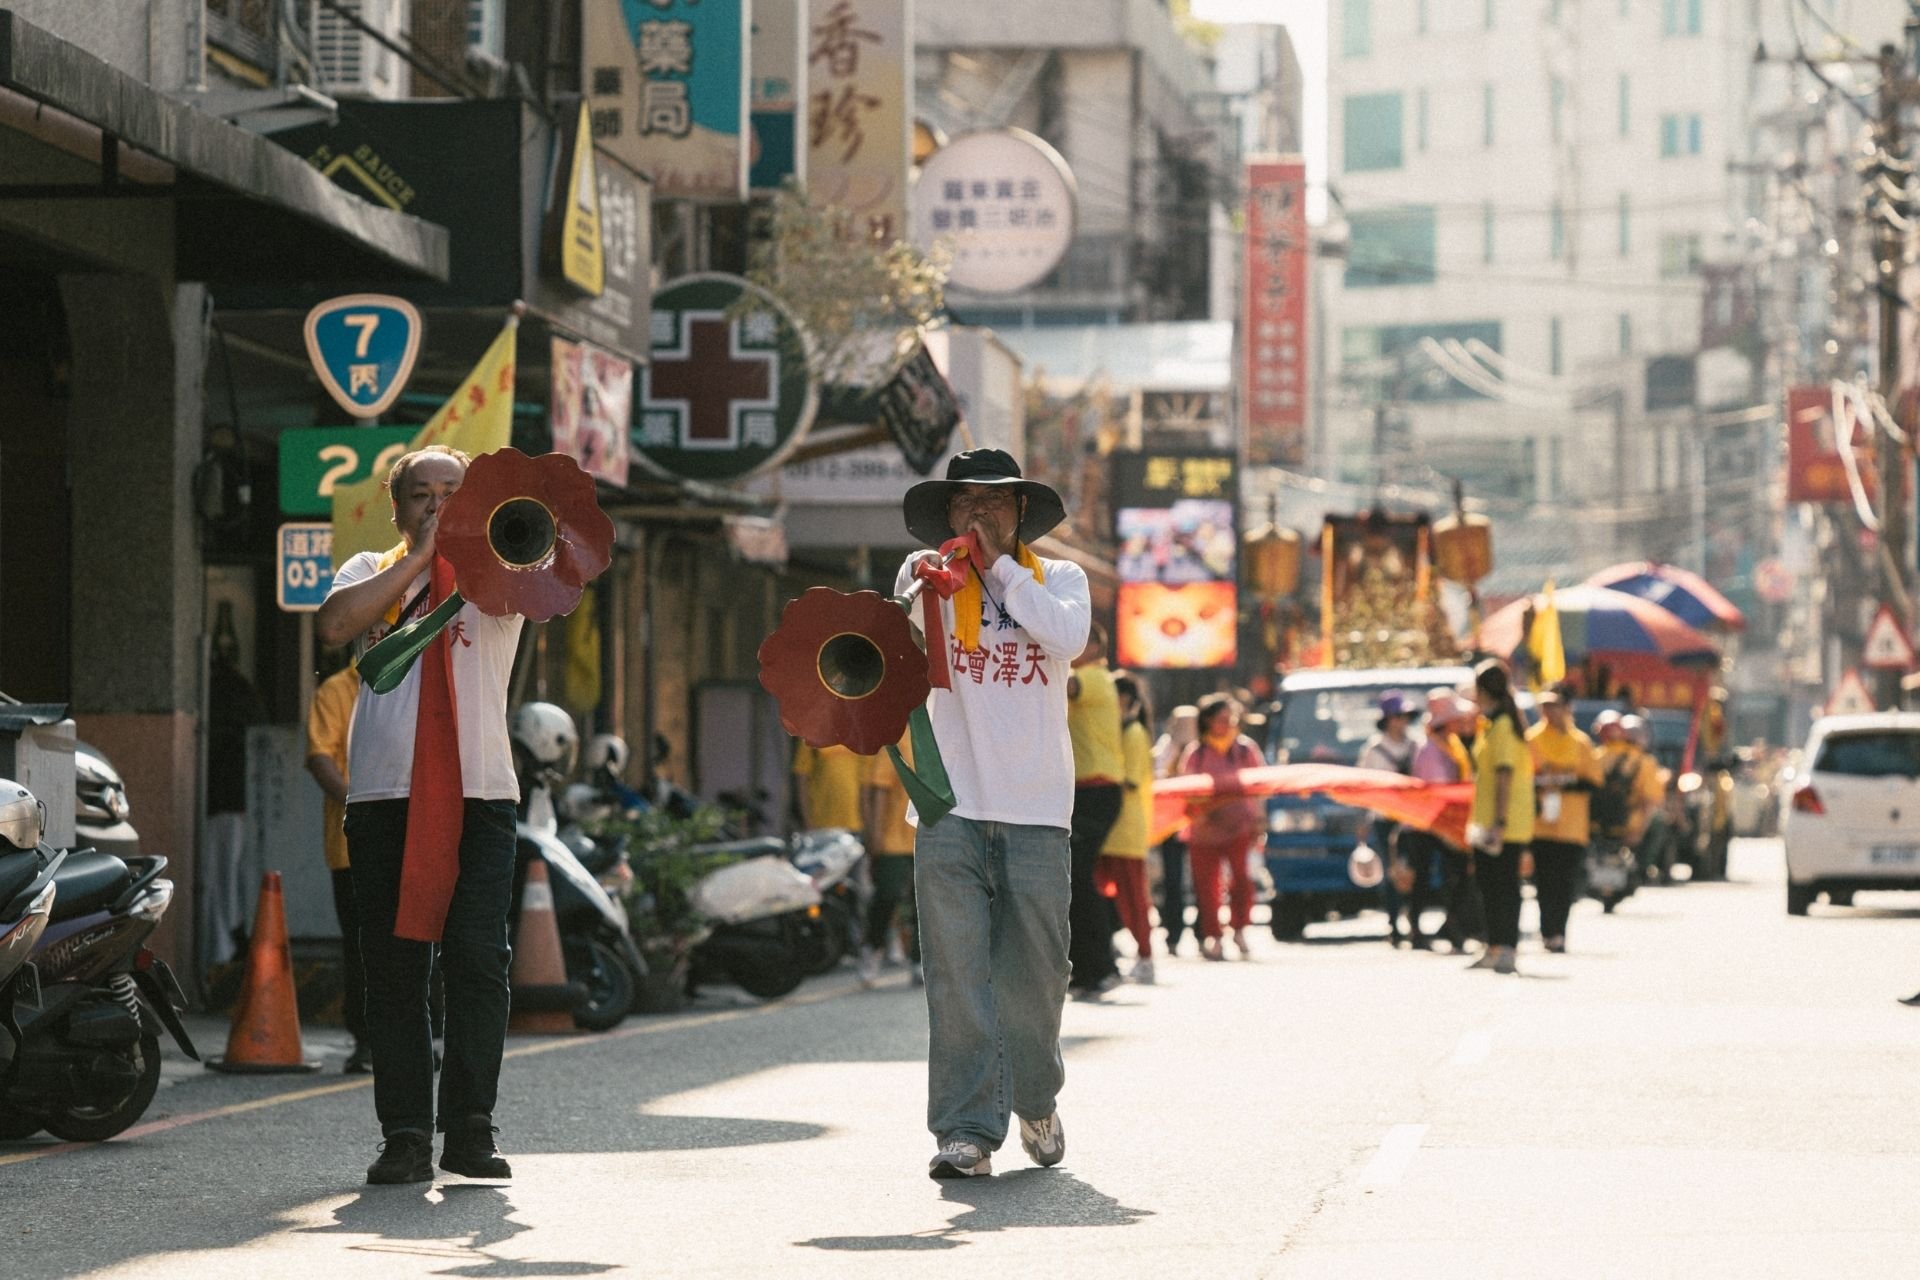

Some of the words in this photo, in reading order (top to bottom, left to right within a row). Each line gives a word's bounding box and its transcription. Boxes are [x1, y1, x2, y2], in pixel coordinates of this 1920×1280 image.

[637, 0, 699, 138] 藥局
[344, 314, 379, 358] 7
[287, 560, 337, 588] 03-
